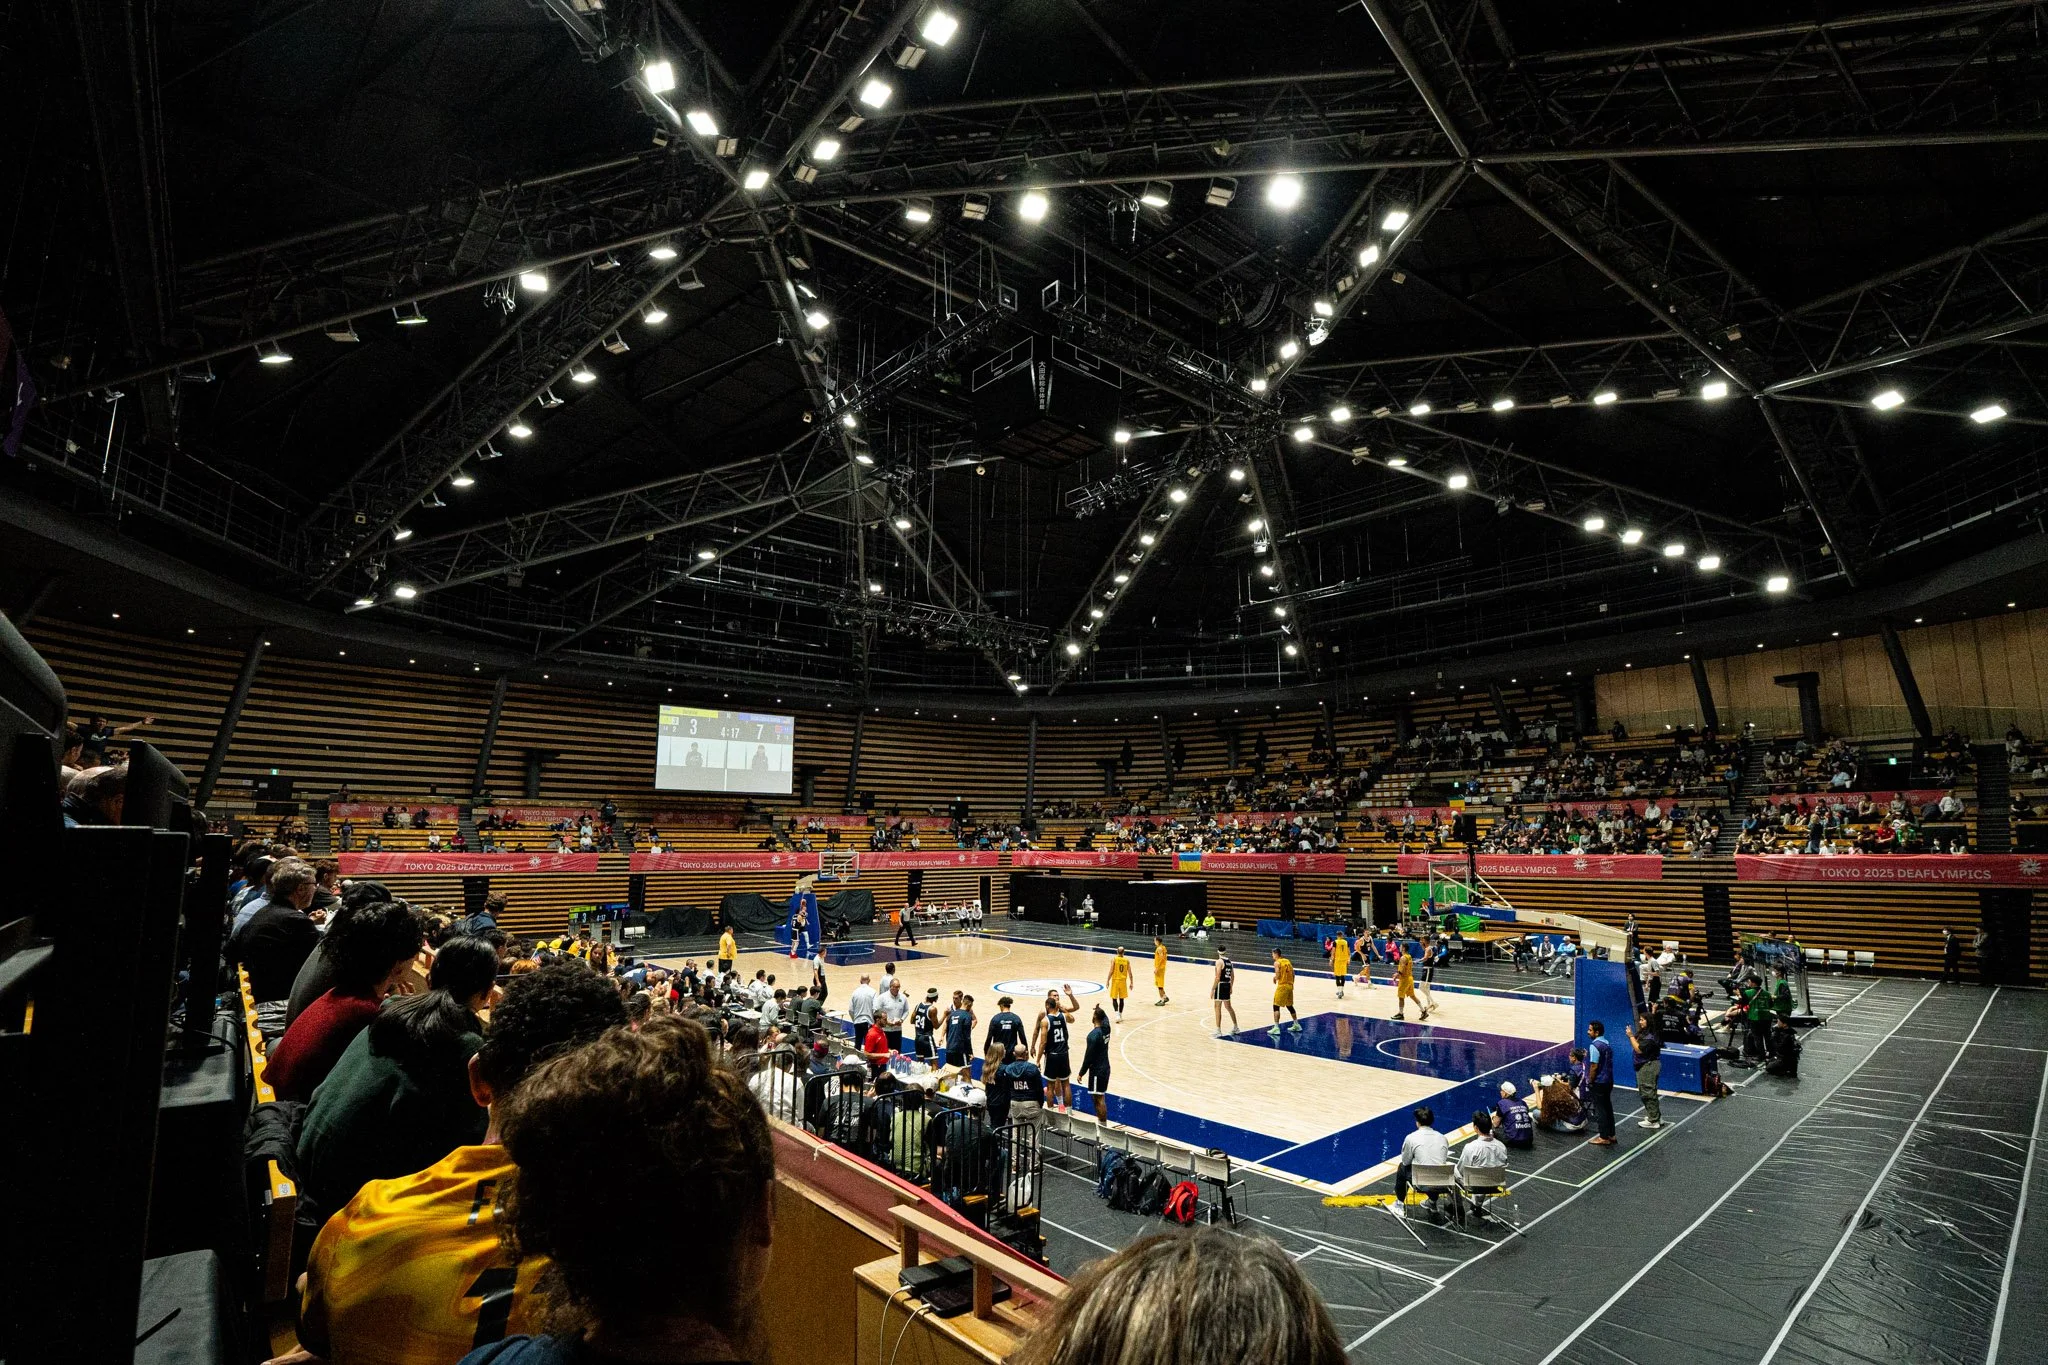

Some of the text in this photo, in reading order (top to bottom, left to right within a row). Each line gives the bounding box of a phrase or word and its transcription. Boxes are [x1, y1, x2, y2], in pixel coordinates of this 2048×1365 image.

[690, 719, 697, 735] 3
[757, 724, 764, 740] 7
[720, 727, 740, 739] 4:17
[458, 863, 513, 871] DEAFLYMPICS
[1479, 865, 1498, 873] 2025
[1499, 866, 1558, 874] DEAFLYMPICS
[1821, 868, 1992, 879] TOKYO 2025 DEAFLYMPICS
[582, 912, 587, 923] 3
[613, 910, 618, 920] 7
[1119, 964, 1124, 973] 0
[915, 1015, 926, 1029] 24
[1053, 1028, 1065, 1043] 21
[1014, 1081, 1029, 1090] USA
